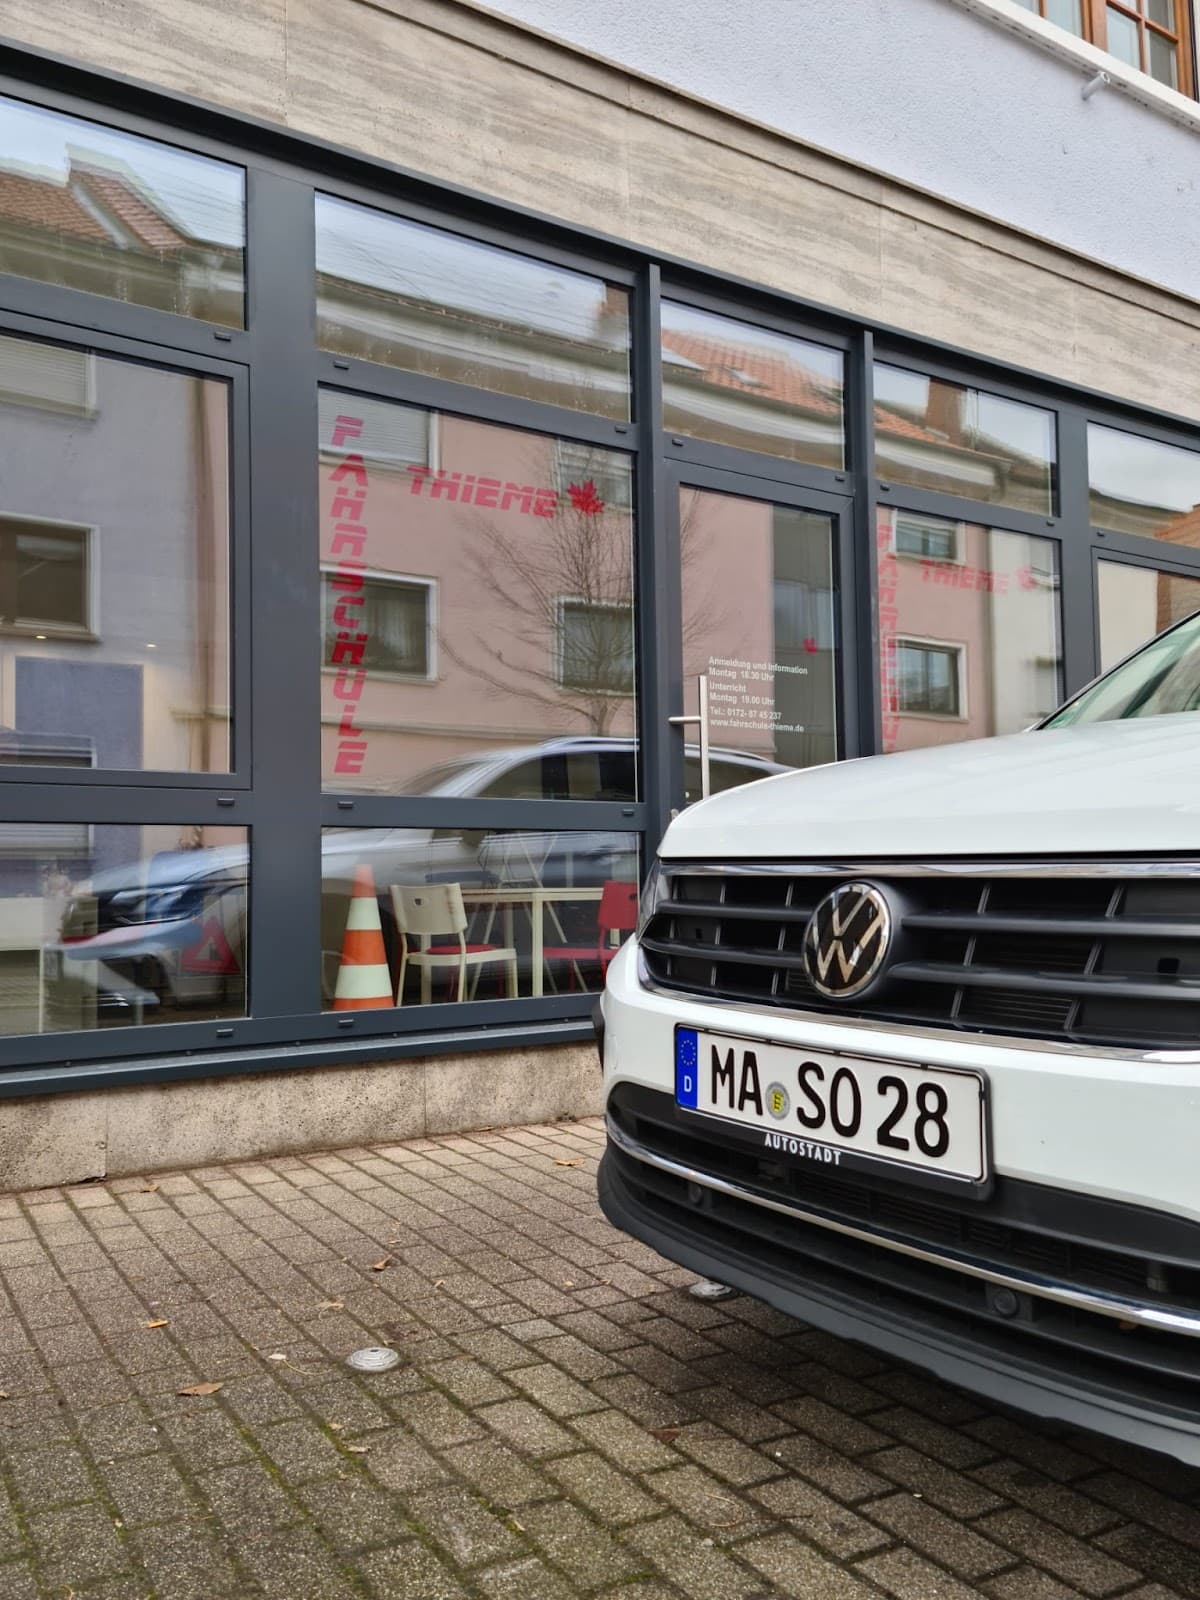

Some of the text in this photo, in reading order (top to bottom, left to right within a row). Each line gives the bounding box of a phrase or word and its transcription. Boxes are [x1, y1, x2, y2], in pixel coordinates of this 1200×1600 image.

[406, 464, 560, 519] THIEME
[328, 415, 369, 774] FAHRSCHULE
[708, 667, 737, 680] Montag
[761, 671, 776, 681] Uhr
[709, 657, 808, 674] Anmeldung und Information
[709, 681, 747, 693] Unterricht
[709, 692, 738, 705] Montag
[761, 696, 776, 706] Uhr
[769, 711, 782, 720] 237
[683, 1044, 950, 1158] D MA SO 28
[764, 1132, 842, 1166] AUTOSTADT
